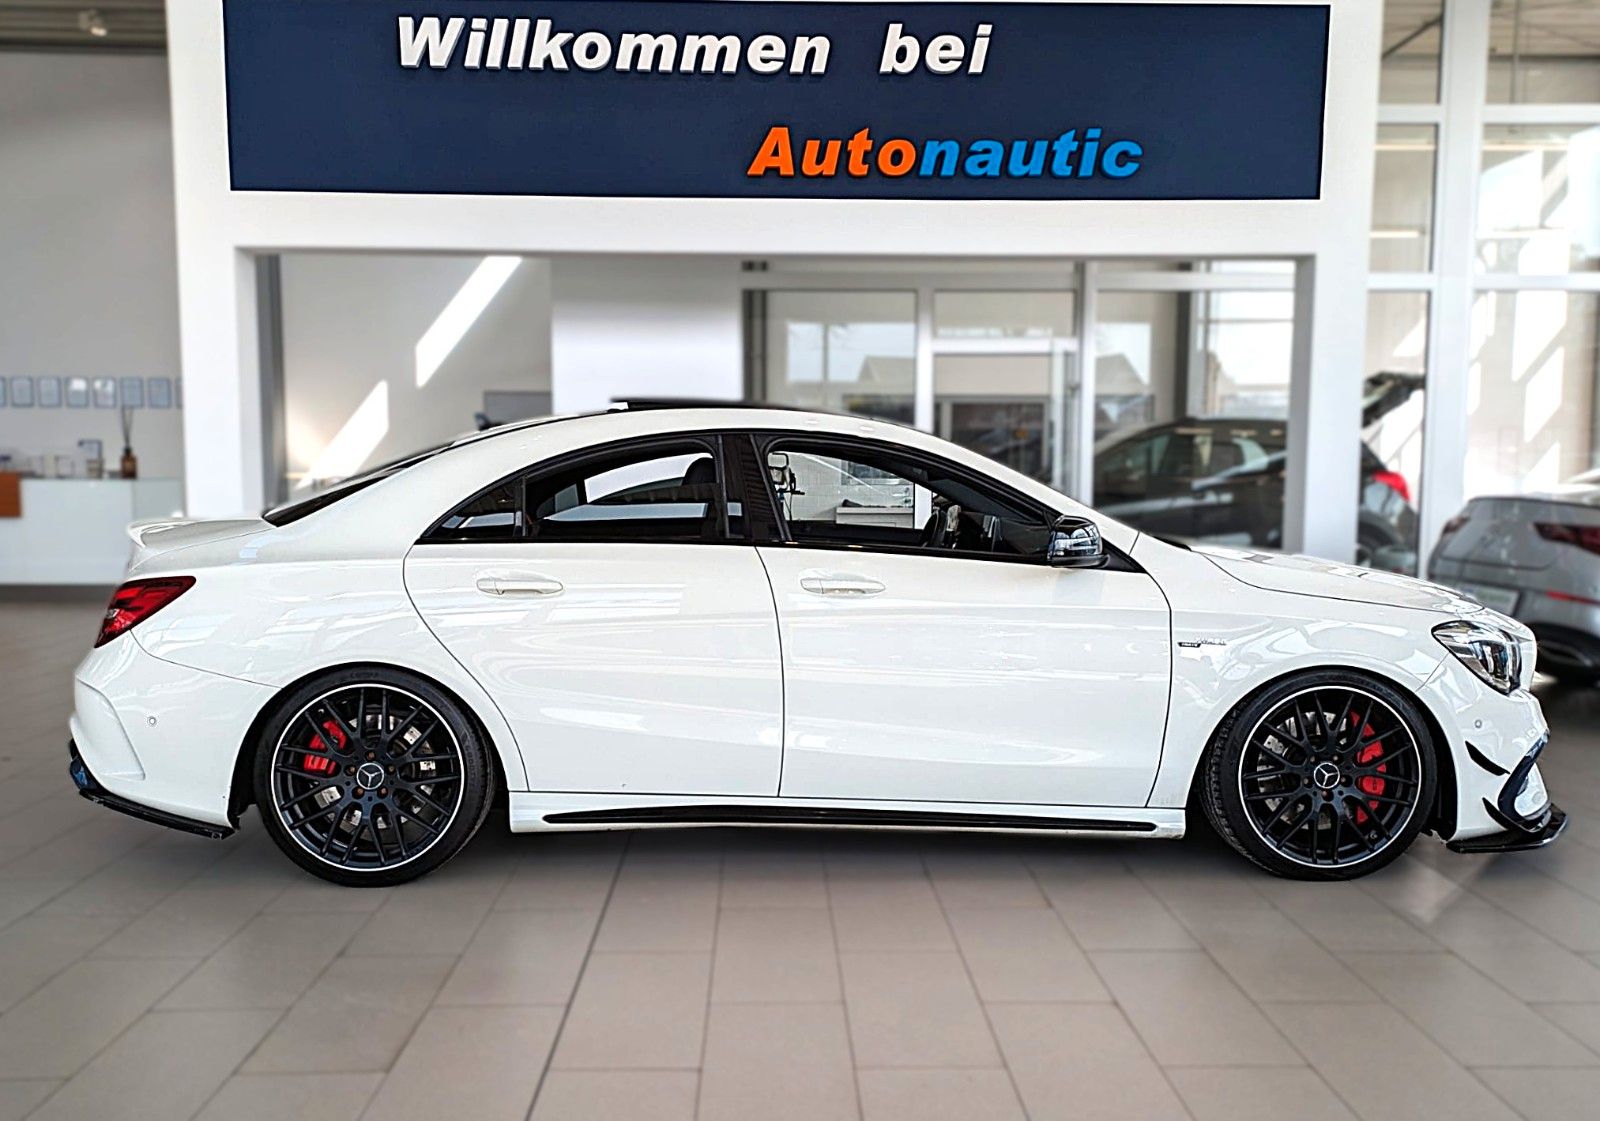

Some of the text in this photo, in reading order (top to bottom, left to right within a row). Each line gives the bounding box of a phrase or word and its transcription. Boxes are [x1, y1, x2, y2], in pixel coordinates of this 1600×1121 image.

[398, 16, 993, 75] Willkommen bei
[746, 126, 1143, 178] Autonautic
